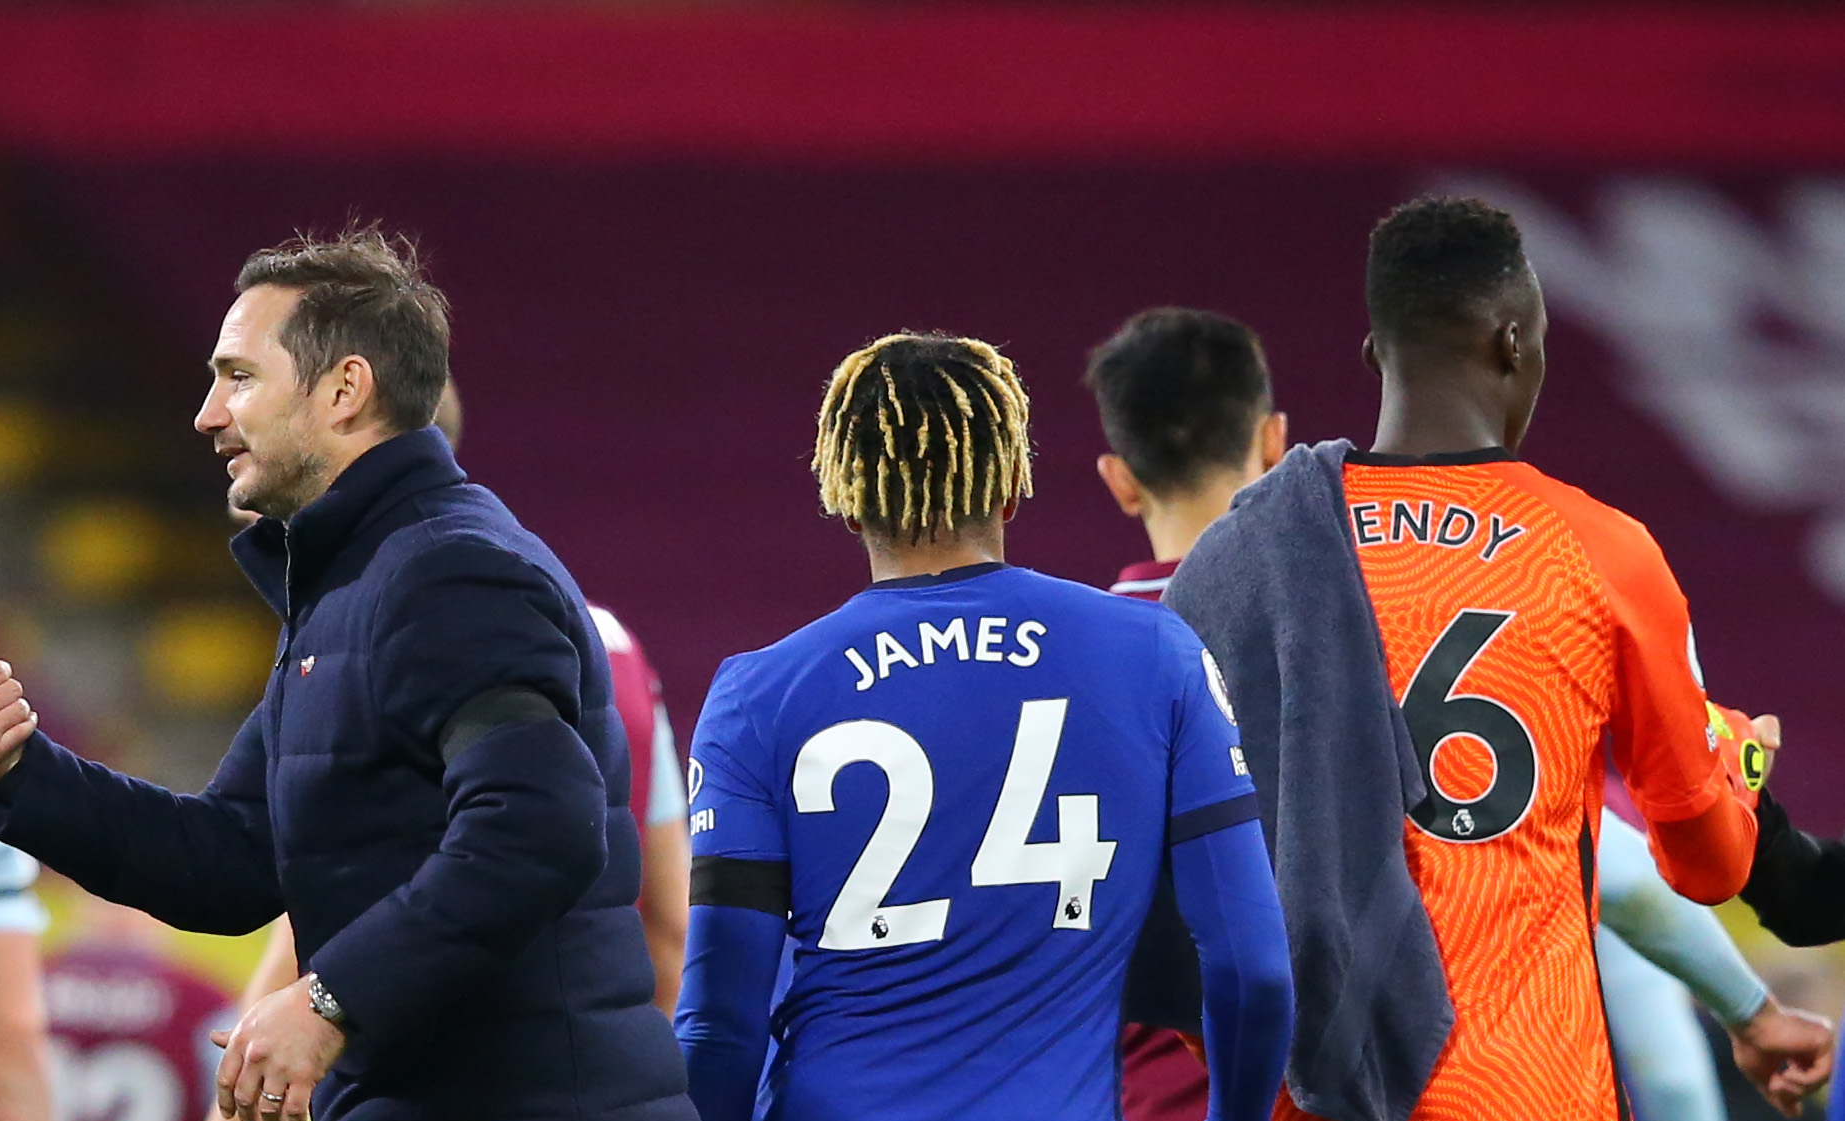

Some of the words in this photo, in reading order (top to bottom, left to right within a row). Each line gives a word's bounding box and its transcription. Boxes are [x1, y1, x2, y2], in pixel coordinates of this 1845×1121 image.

[1351, 501, 1526, 561] ENDY
[844, 617, 1047, 691] JAMES
[792, 698, 1117, 951] 24
